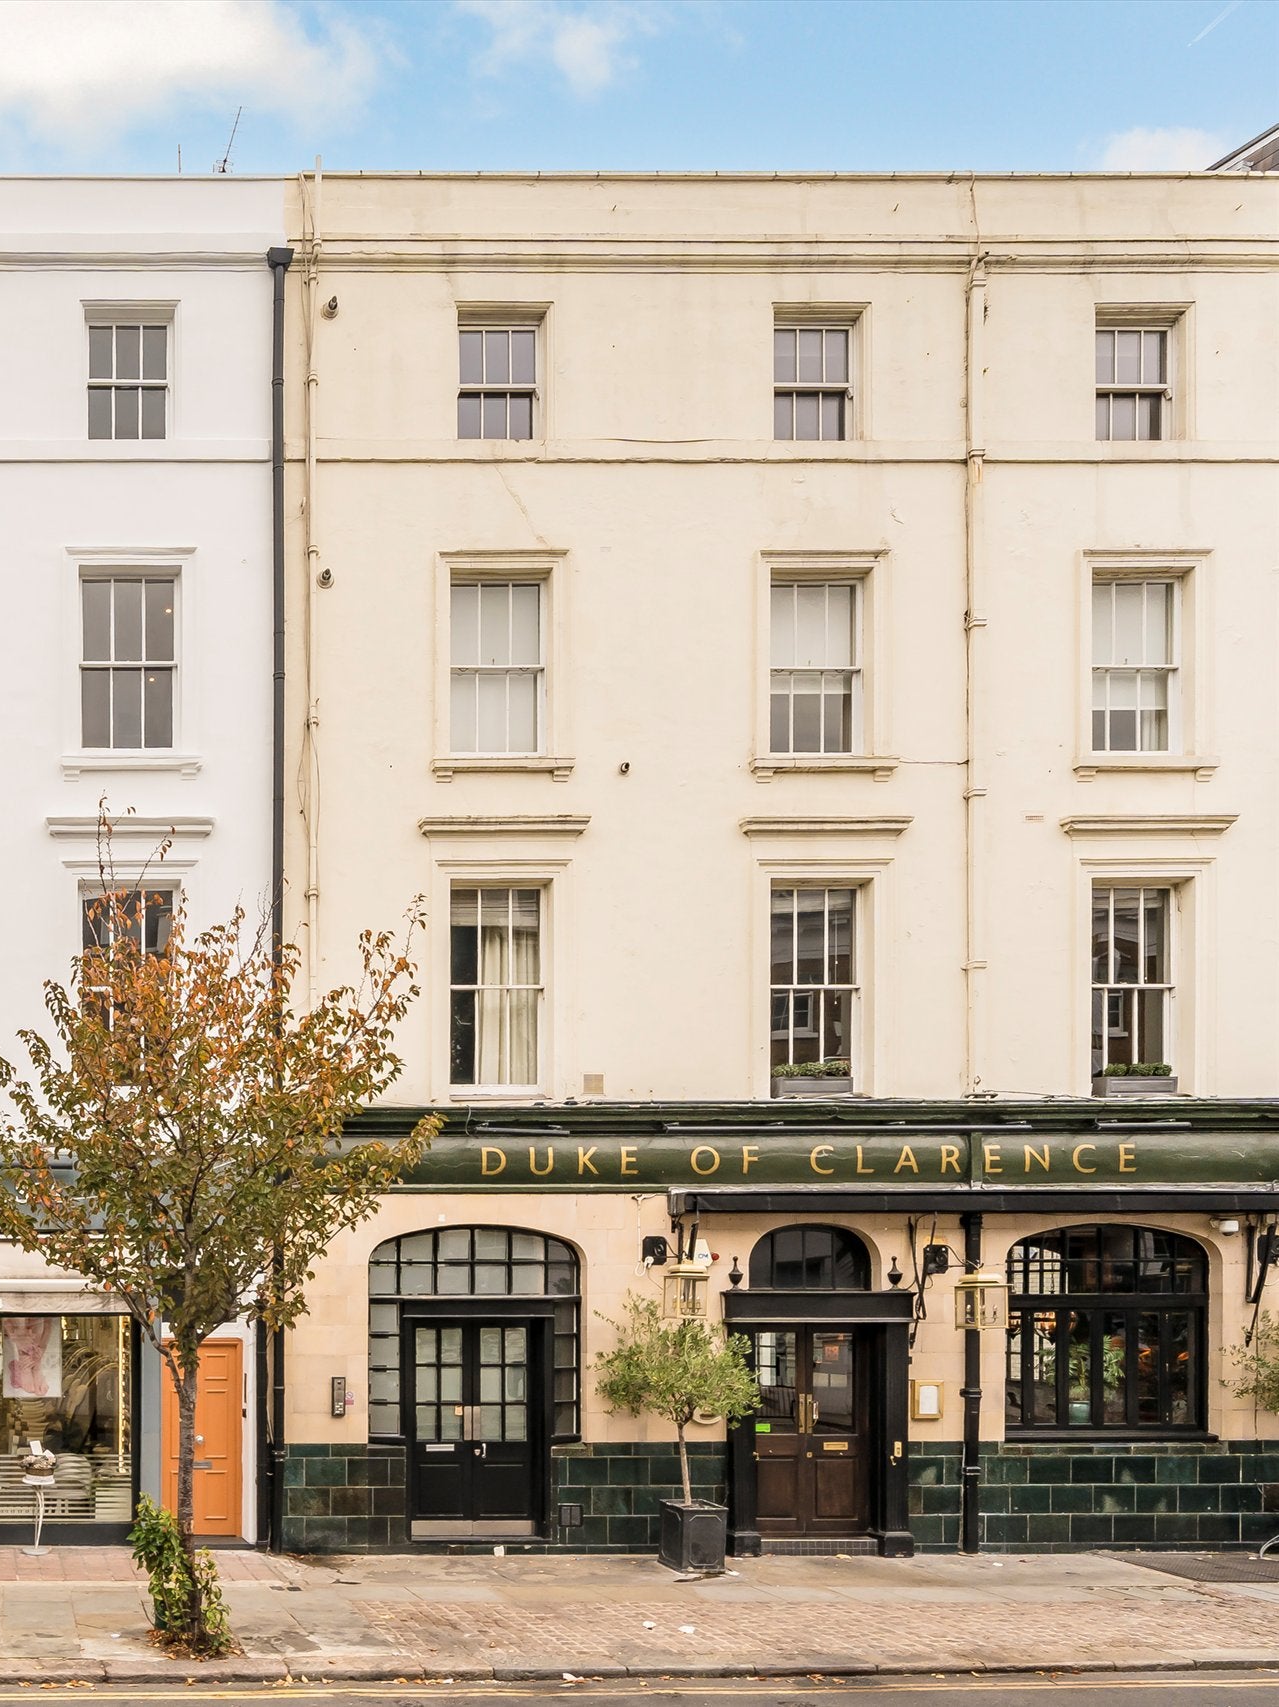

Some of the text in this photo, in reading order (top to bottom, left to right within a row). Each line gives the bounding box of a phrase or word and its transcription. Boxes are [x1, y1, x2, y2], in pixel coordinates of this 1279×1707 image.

[480, 1143, 1139, 1177] DUKE OF CLARENCE
